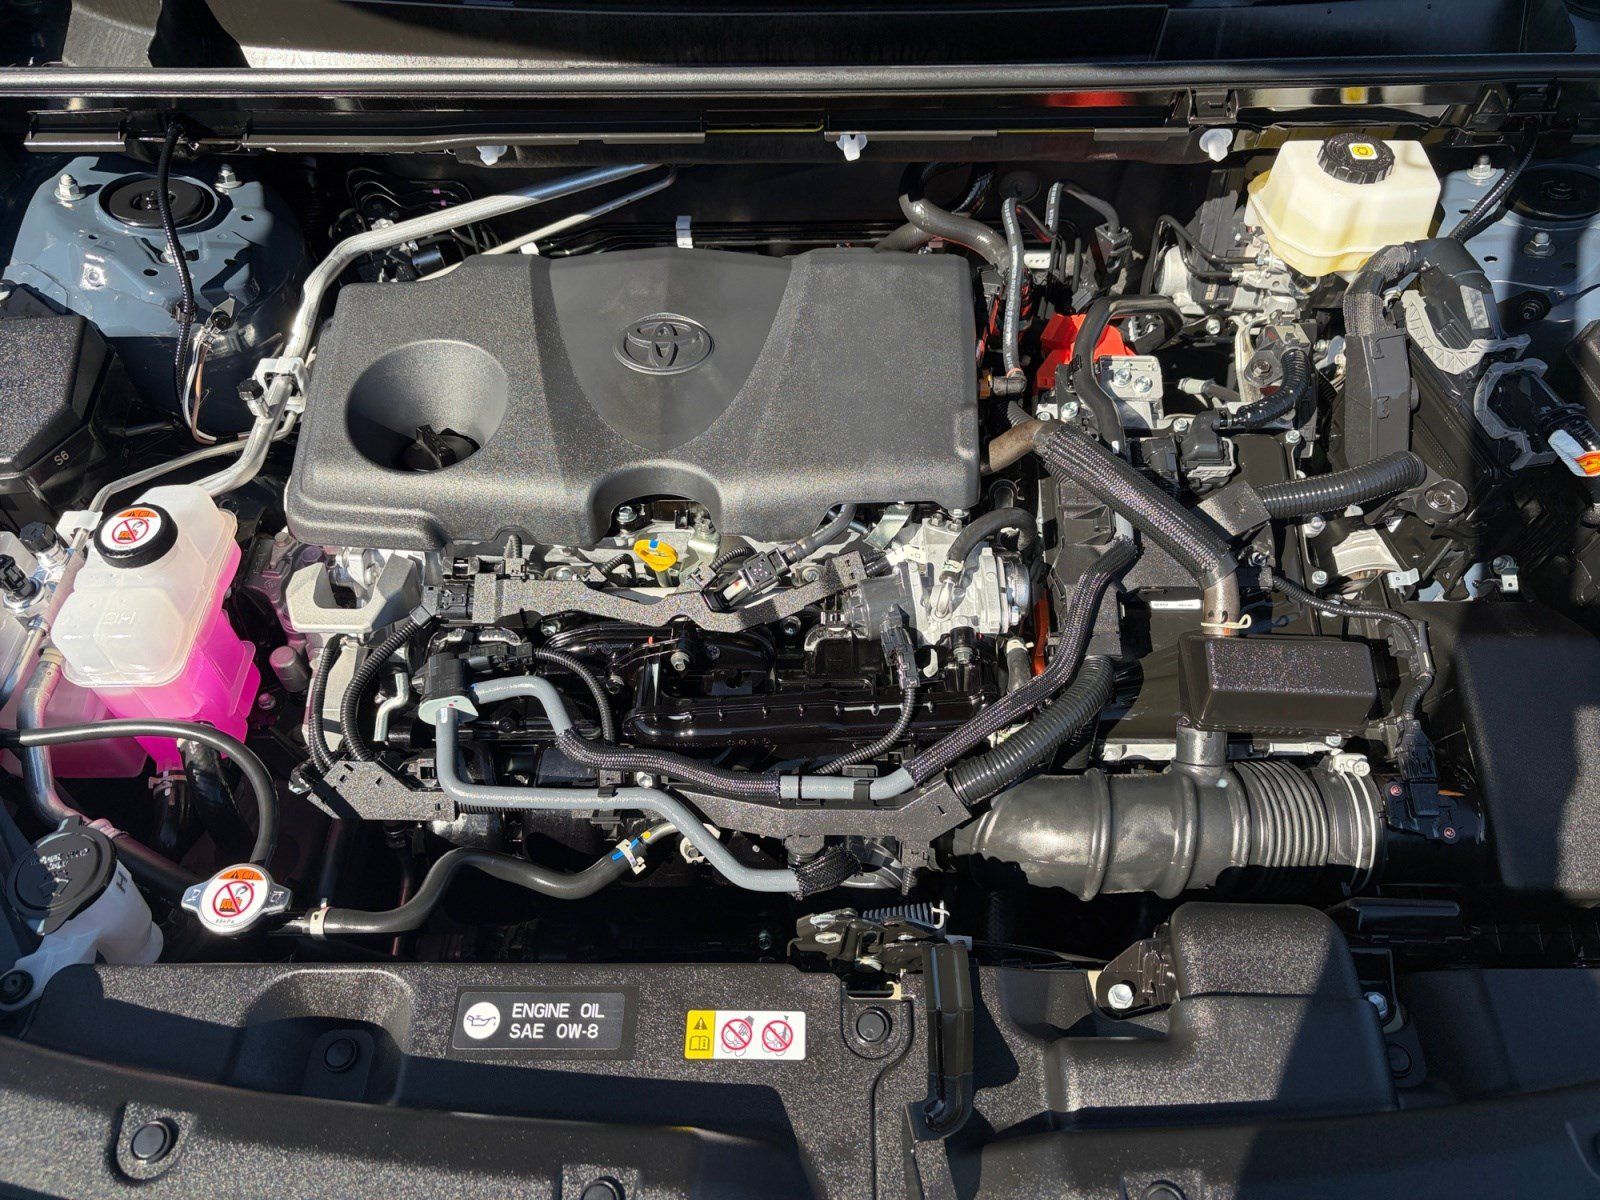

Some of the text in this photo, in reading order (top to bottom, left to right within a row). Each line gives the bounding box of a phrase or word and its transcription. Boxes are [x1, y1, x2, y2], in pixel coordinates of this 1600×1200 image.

[511, 1002, 605, 1019] ENGINE OIL
[509, 1023, 600, 1039] SAE 0W-8
